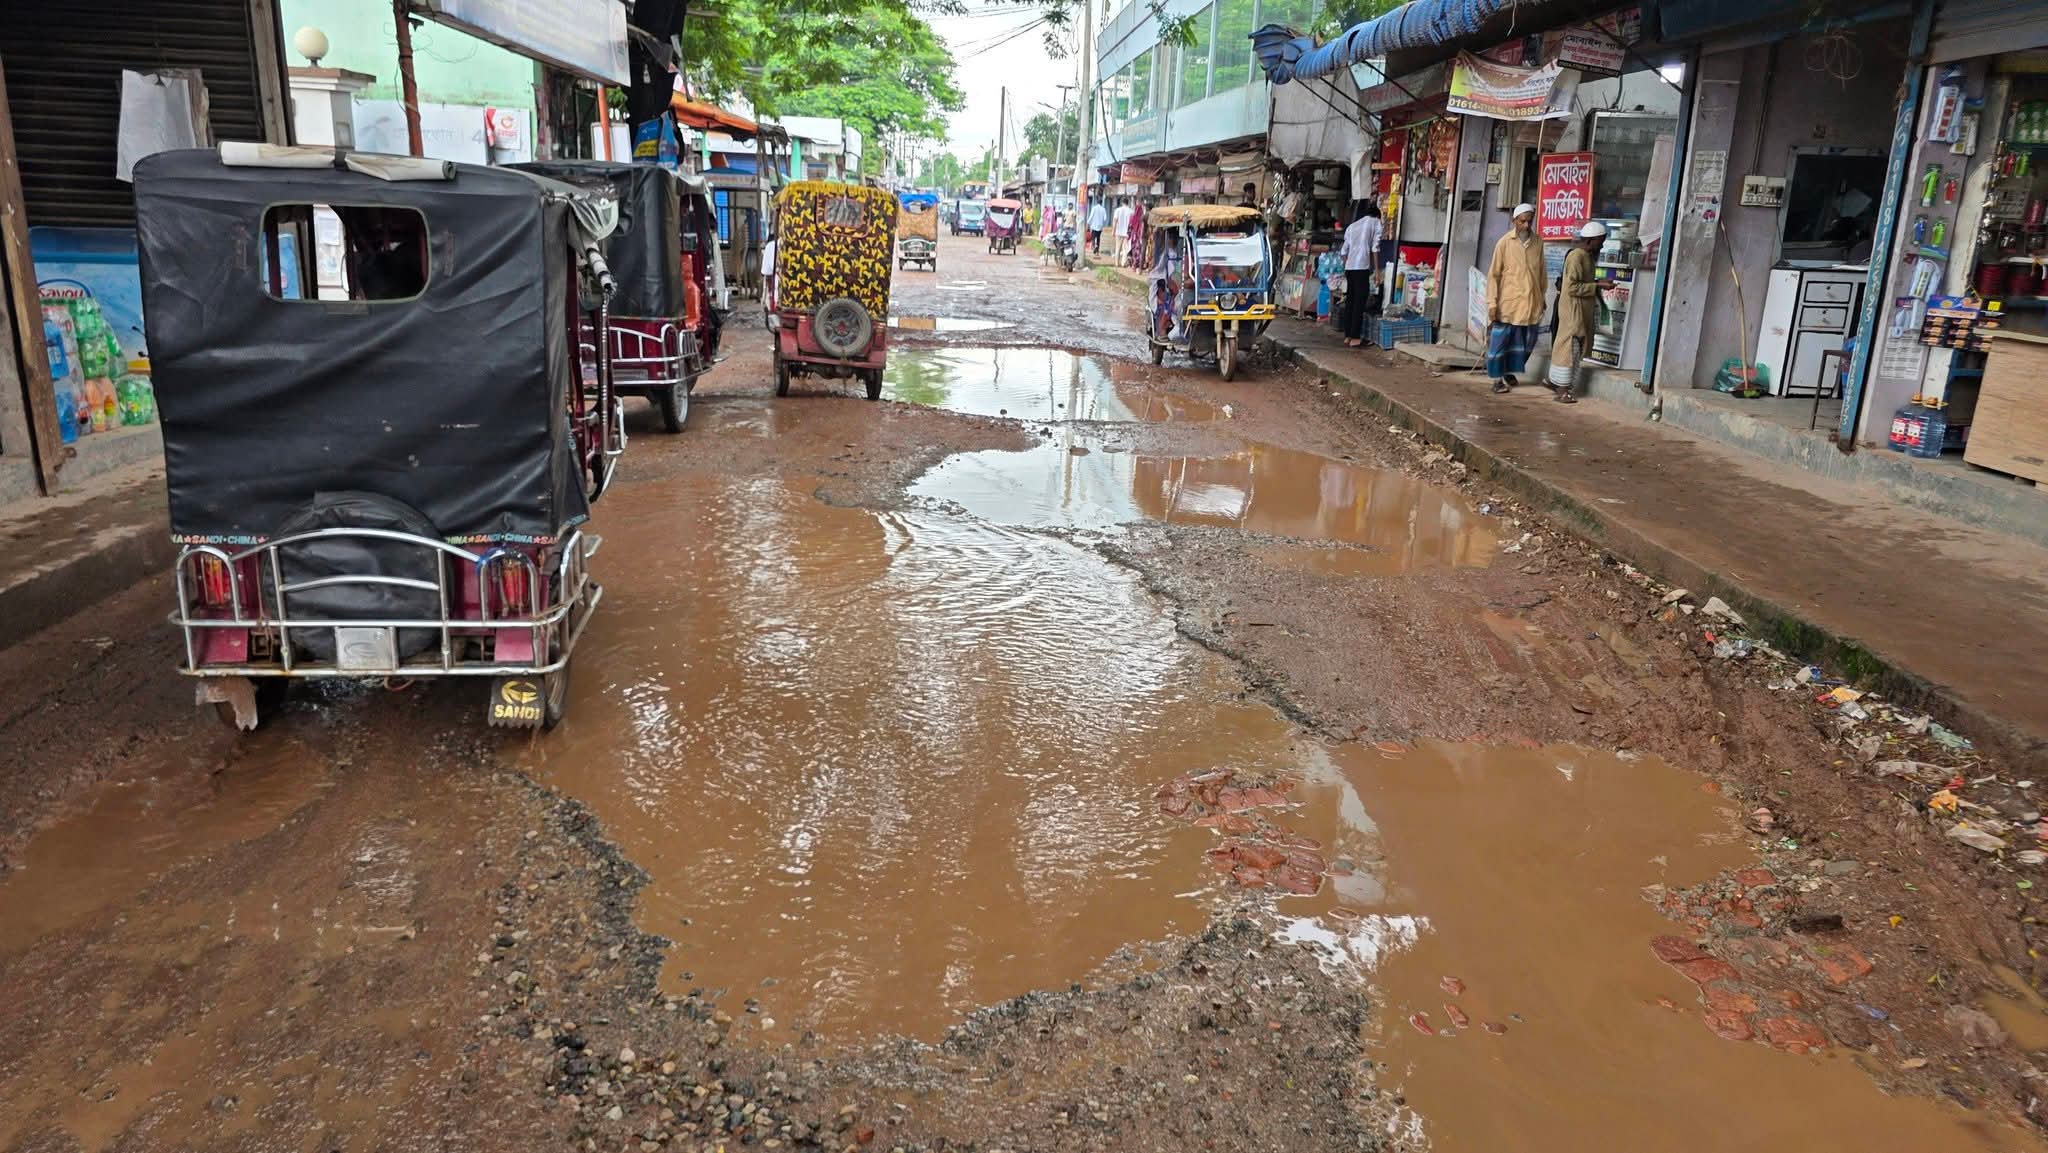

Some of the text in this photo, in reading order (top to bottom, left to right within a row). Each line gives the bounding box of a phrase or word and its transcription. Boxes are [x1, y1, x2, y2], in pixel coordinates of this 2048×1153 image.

[1543, 156, 1590, 186] মোবাইল
[1542, 189, 1584, 220] সার্ভিসিং
[1543, 225, 1561, 235] করা
[494, 704, 540, 720] SANDI
